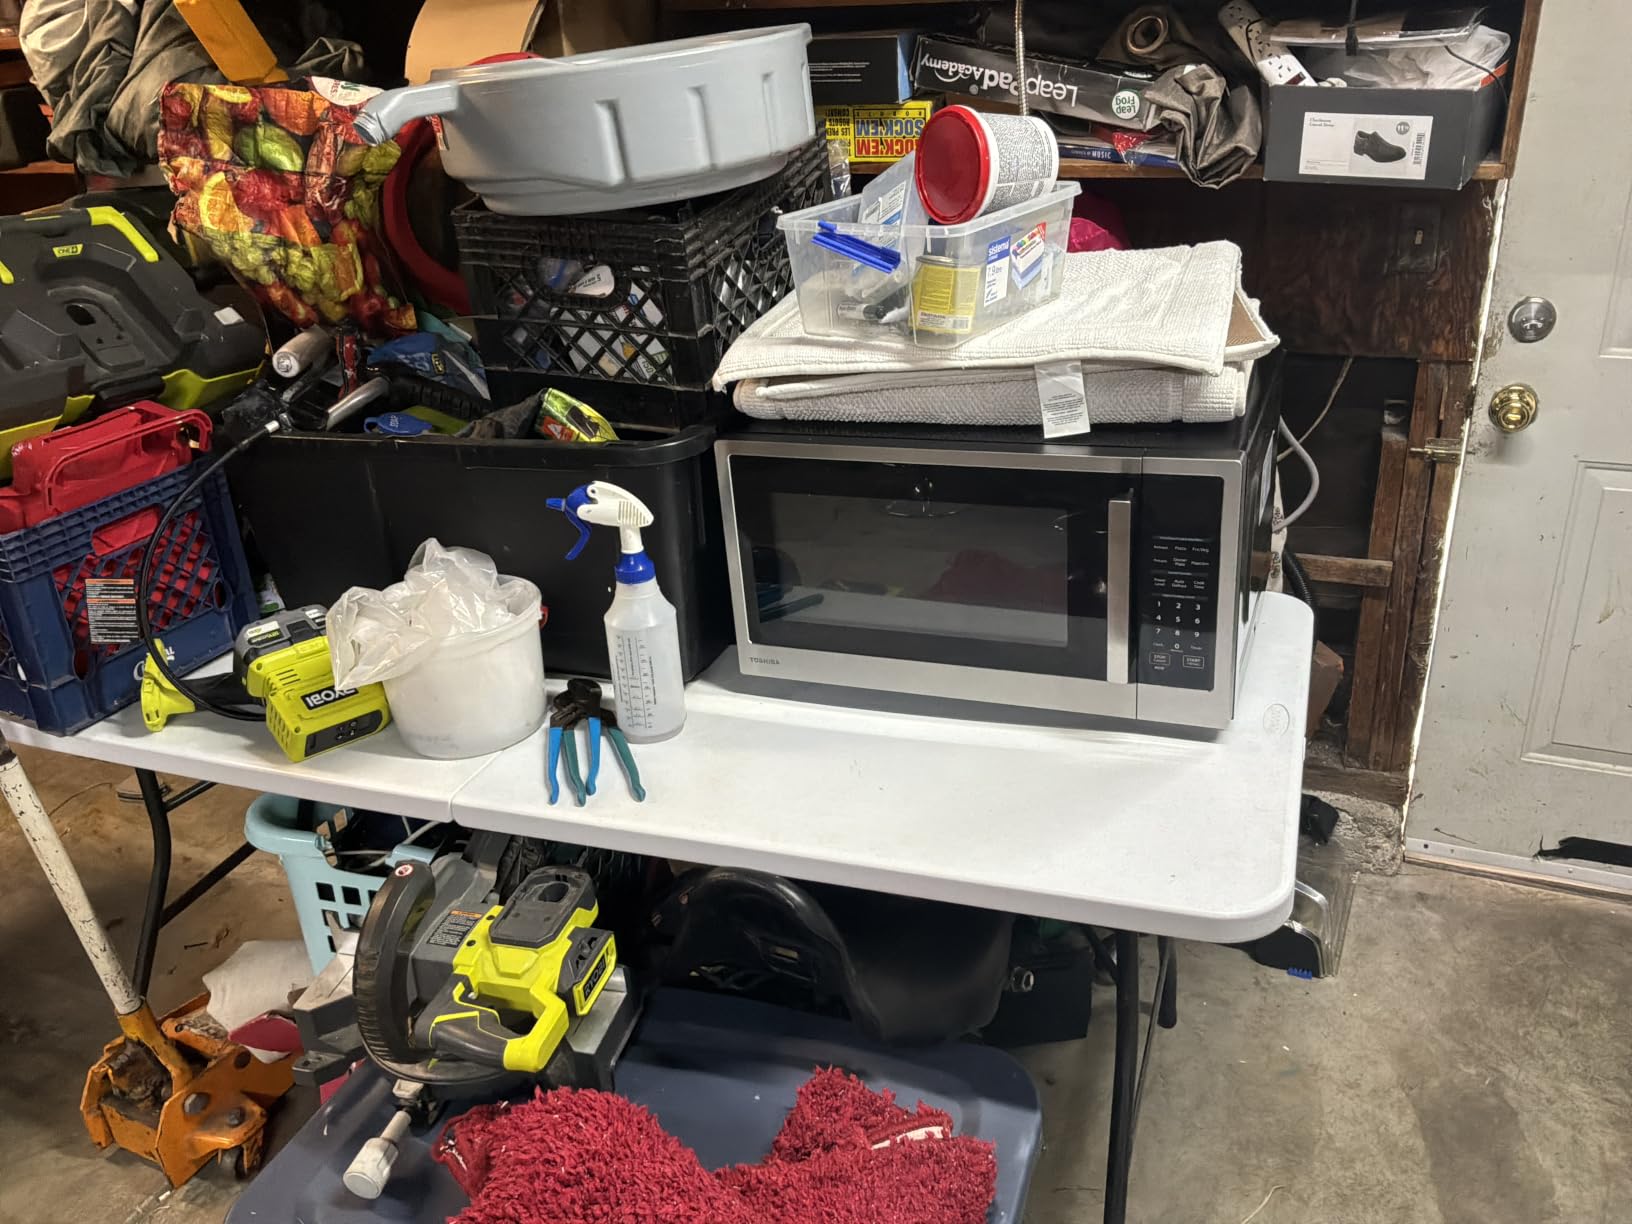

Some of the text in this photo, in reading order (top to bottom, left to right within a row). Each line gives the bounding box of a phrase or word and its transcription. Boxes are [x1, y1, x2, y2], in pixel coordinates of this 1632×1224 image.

[920, 53, 982, 80] Academy
[1115, 95, 1135, 105] Frog
[1116, 104, 1136, 114] Leap
[857, 119, 925, 136] SOCK'EM
[857, 138, 921, 156] OCK'EM
[1092, 150, 1111, 159] MUSIC
[749, 656, 781, 665] TOSHIBA
